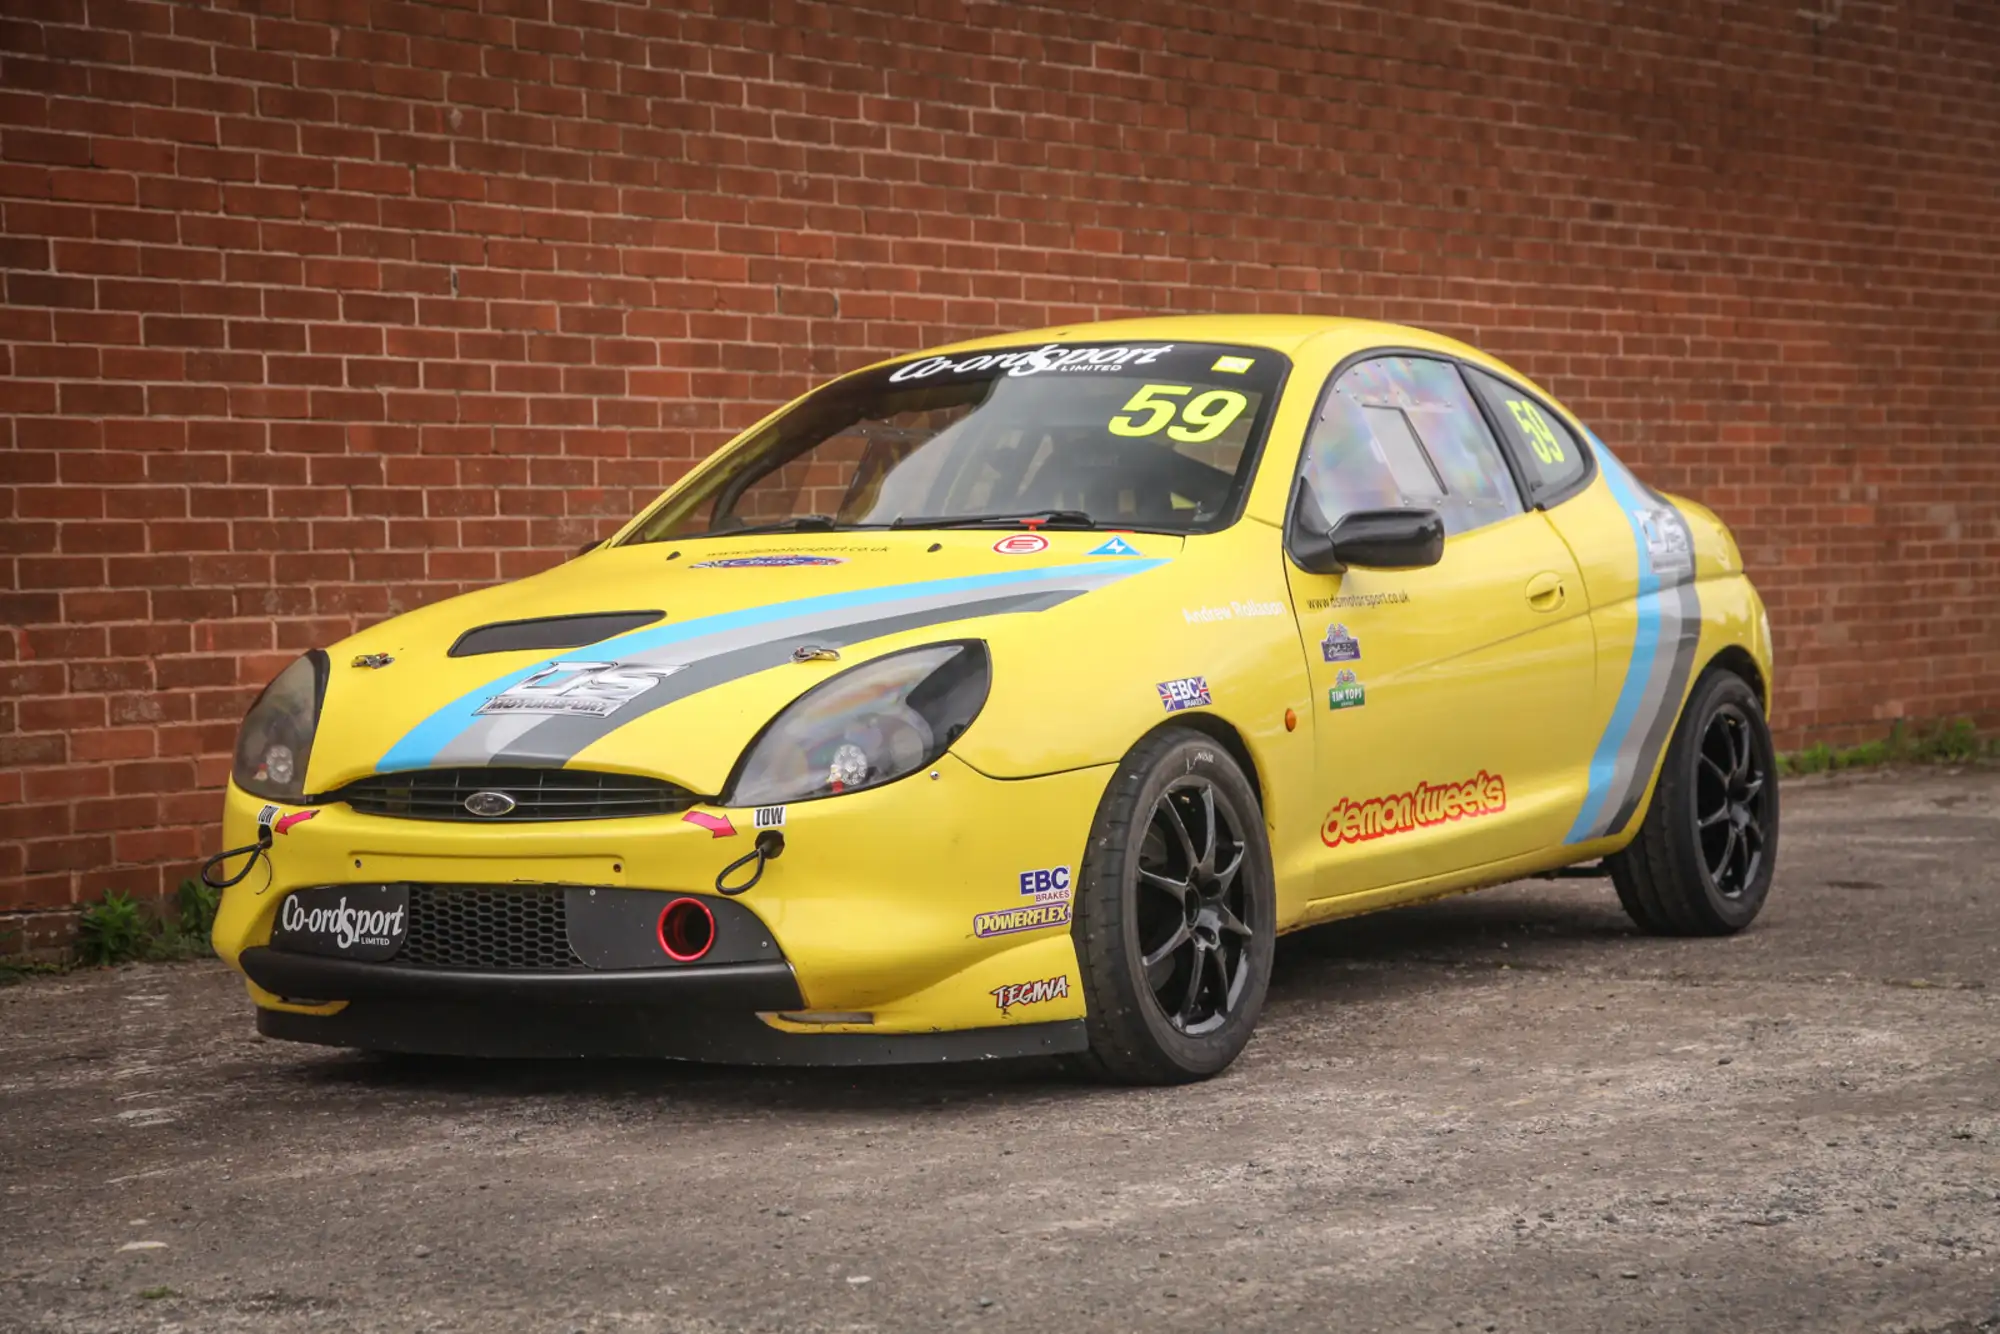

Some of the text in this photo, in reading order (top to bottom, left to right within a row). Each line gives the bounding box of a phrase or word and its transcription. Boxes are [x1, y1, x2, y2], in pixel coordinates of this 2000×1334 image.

[1061, 364, 1122, 372] LIMITED
[1108, 384, 1247, 442] 59
[1506, 400, 1565, 464] 59
[1306, 590, 1411, 609] www.dsmotorsport.co.uk
[1182, 605, 1232, 625] Andrew
[1167, 678, 1200, 701] EBC
[1332, 688, 1362, 702] TIN TOPS
[756, 806, 784, 826] TOW
[1321, 769, 1506, 847] demon tweeks
[1020, 867, 1069, 894] EBC
[1036, 890, 1070, 902] BRAKES
[282, 895, 404, 948] Co-ordSport
[976, 903, 1067, 935] POWERFLEX
[361, 937, 390, 945] LIMITED
[990, 975, 1069, 1008] TEGIWA
